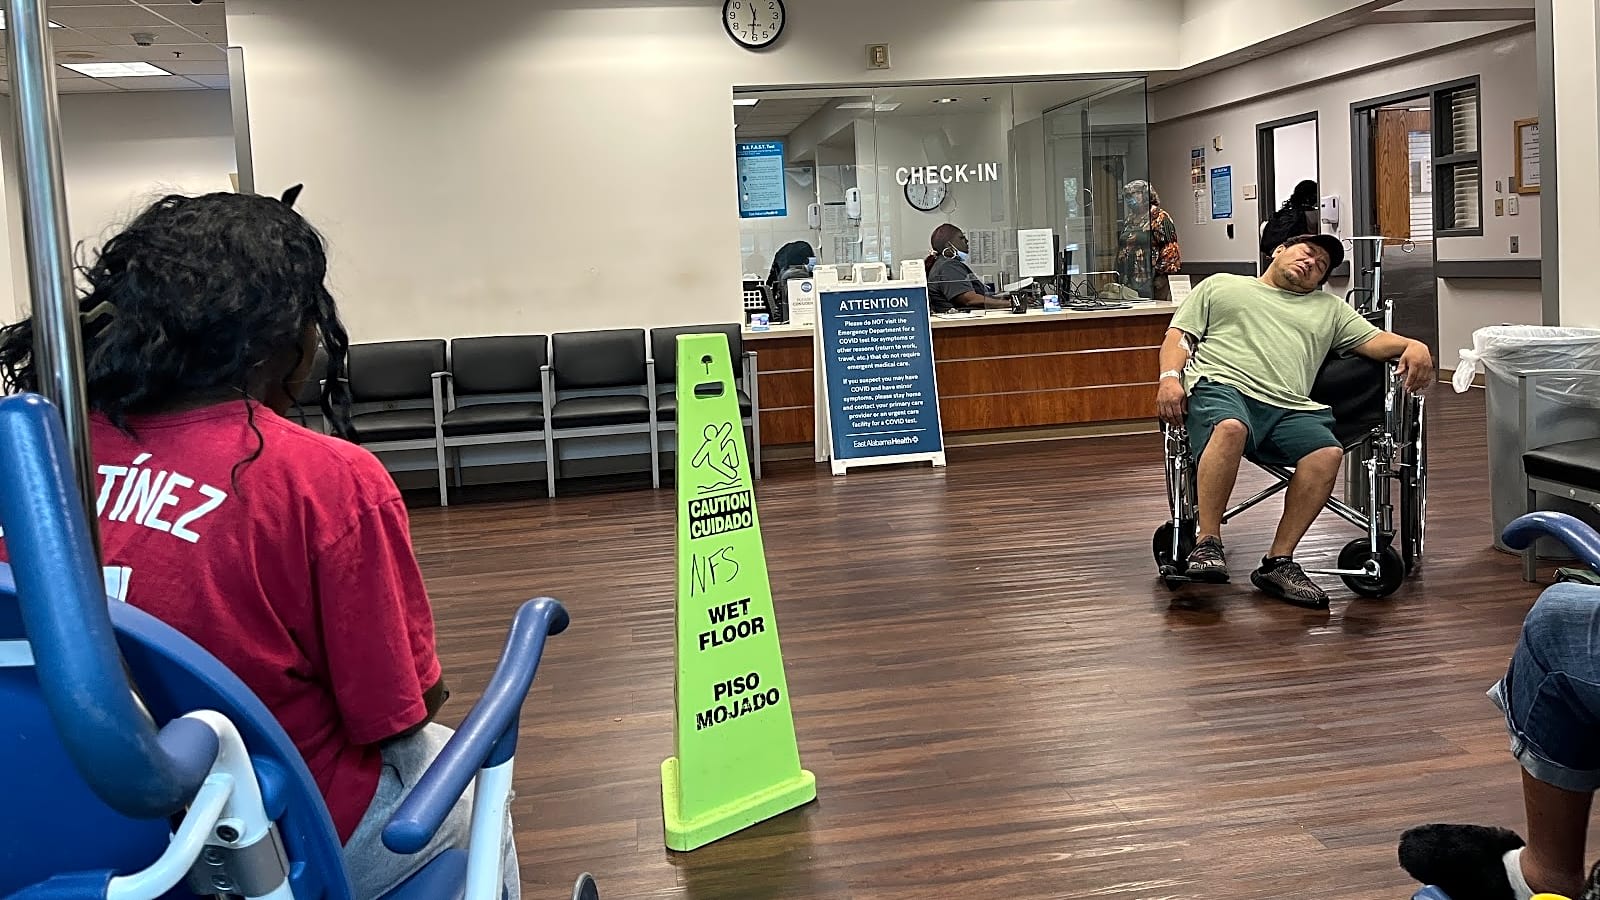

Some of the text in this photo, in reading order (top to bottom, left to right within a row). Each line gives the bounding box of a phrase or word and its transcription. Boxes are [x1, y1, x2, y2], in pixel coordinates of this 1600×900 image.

[896, 162, 998, 185] CHECK-IN
[840, 297, 908, 311] ATTENTION
[97, 453, 228, 543] TÍNEZ
[691, 492, 749, 518] CAUTION
[691, 511, 751, 538] CUIDADO
[691, 546, 738, 597] NFS
[708, 598, 751, 624] WET
[699, 617, 764, 651] FLOOR
[714, 673, 760, 702] PISO
[696, 688, 780, 730] MOJADO
